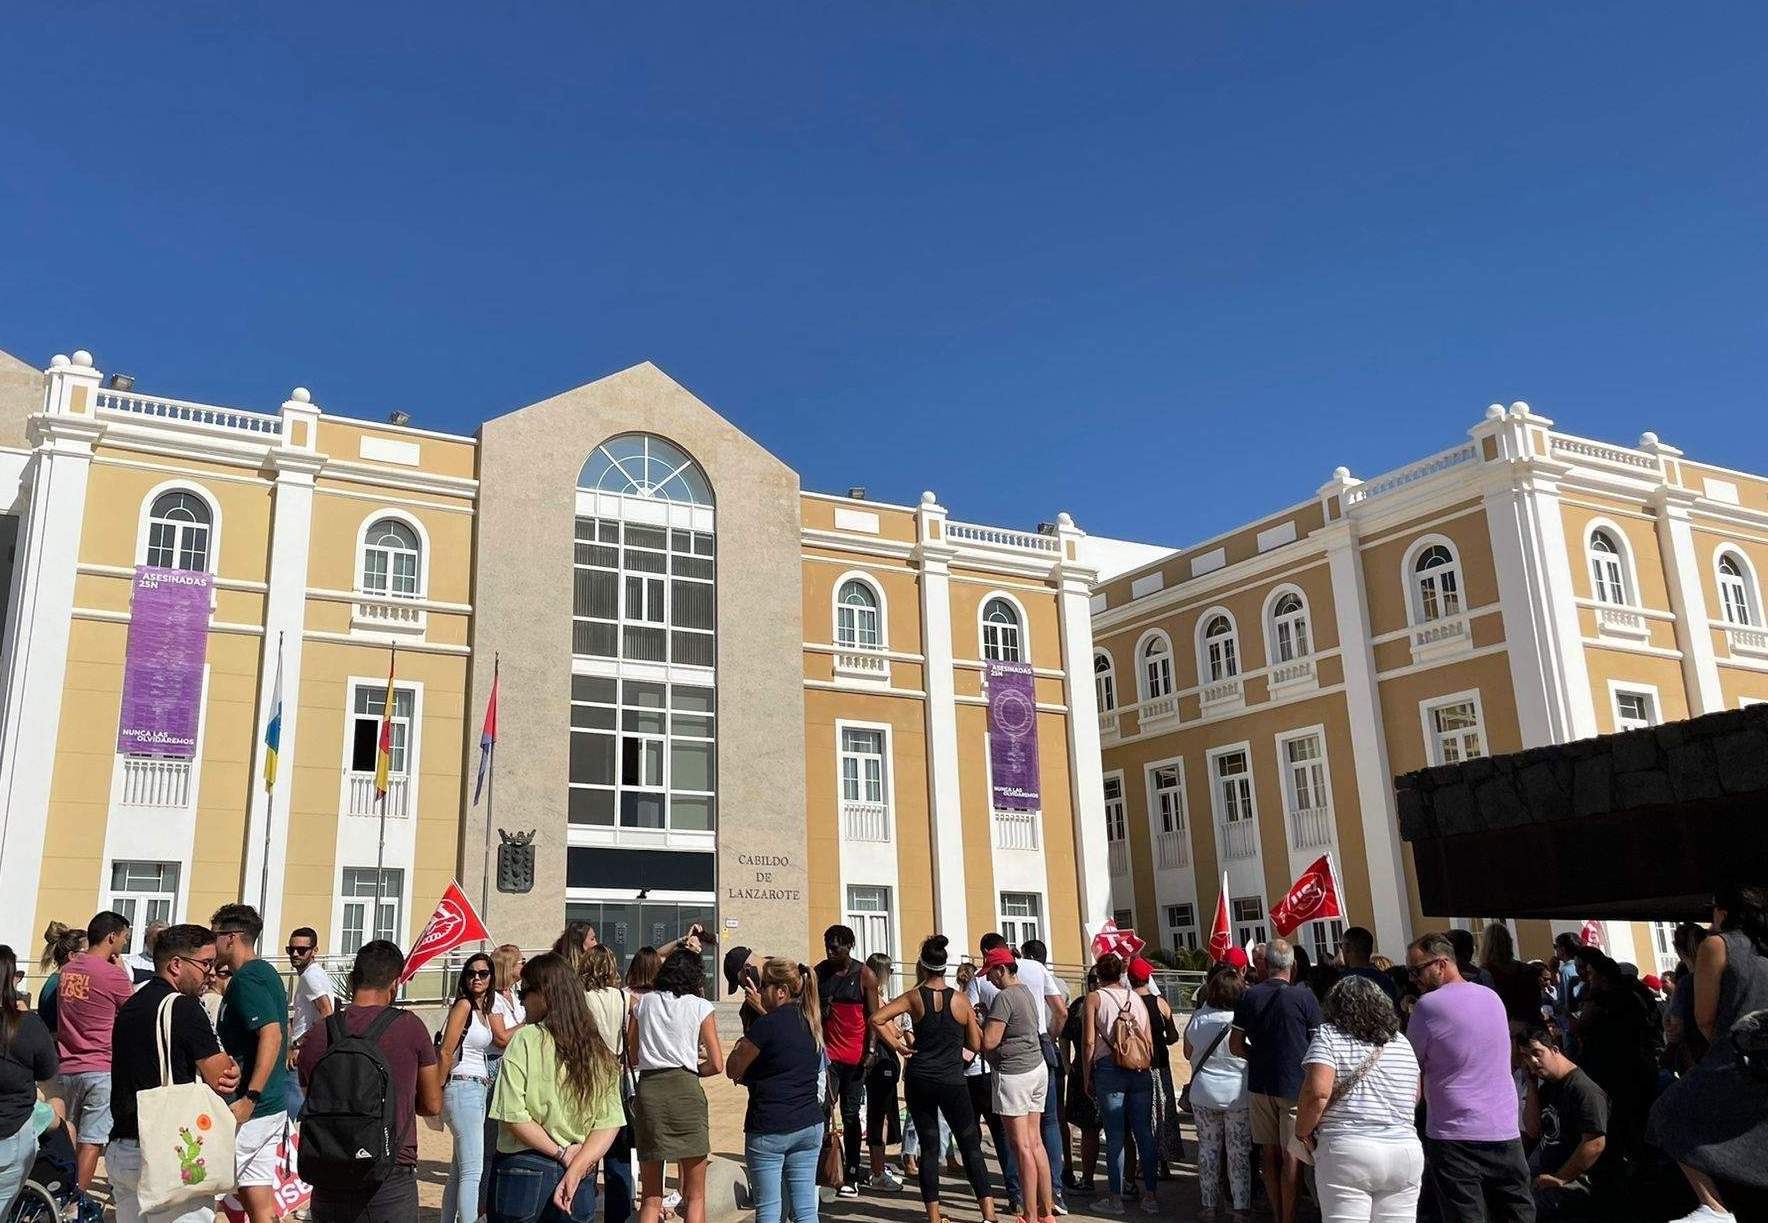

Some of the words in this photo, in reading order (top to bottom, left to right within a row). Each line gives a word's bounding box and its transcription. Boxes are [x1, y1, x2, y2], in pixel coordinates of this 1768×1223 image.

[139, 580, 159, 589] 25N
[142, 572, 207, 587] ASESINADAS
[992, 664, 1032, 675] ASESINADAS
[122, 728, 152, 737] NUNCA
[136, 735, 195, 745] OLVIDAREMOS
[738, 854, 790, 867] CABILDO
[755, 872, 773, 883] DE
[728, 888, 801, 901] LANZAROTE
